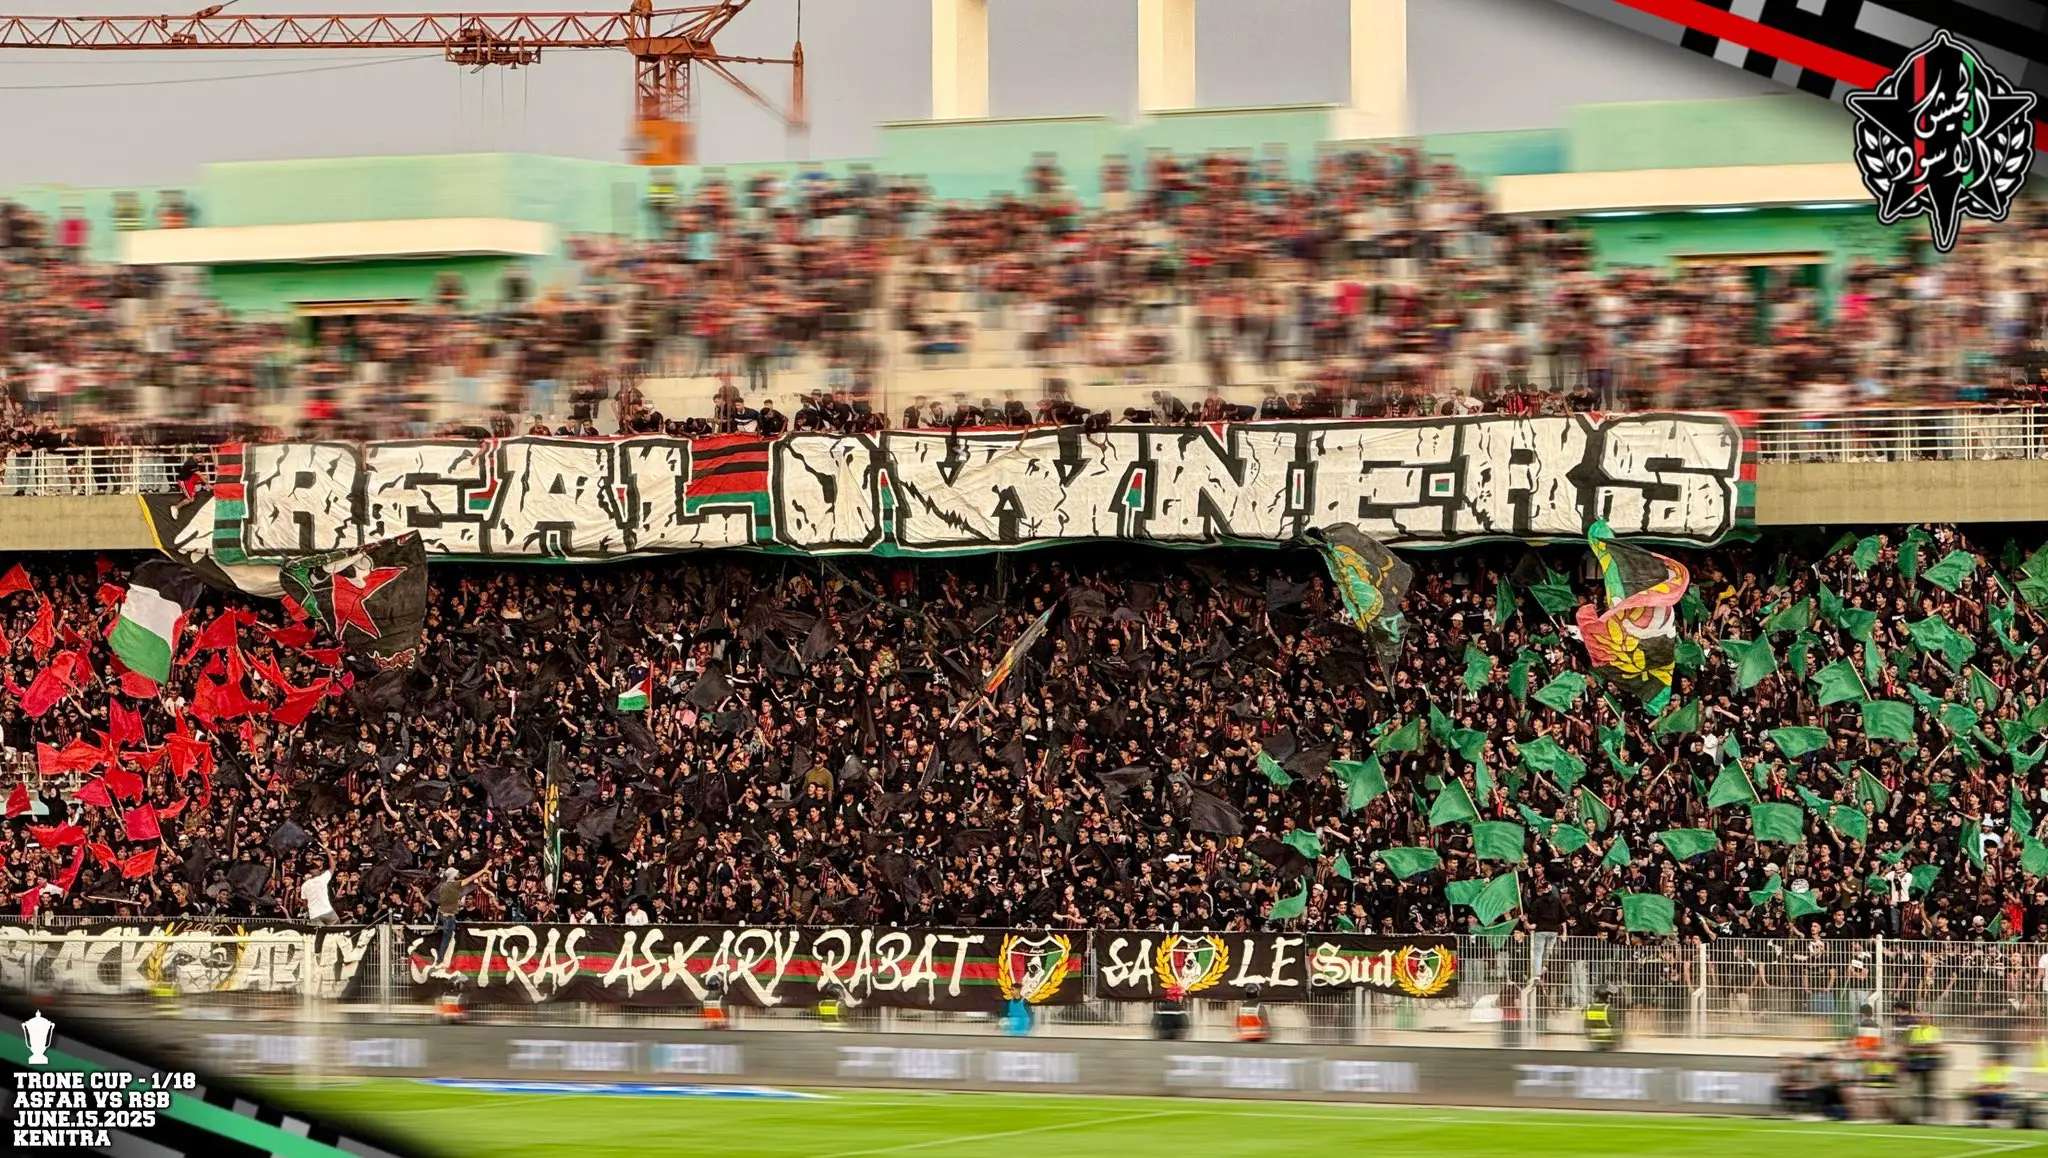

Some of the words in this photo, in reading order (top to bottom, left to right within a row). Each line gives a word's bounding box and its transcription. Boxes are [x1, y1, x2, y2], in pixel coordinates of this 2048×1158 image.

[244, 434, 756, 556] REAL
[772, 411, 1738, 552] OWNERS
[407, 925, 587, 1004] ULTRAS
[597, 928, 799, 1007] ASKARY
[812, 928, 985, 1008] RABAT
[1311, 942, 1397, 988] Sud
